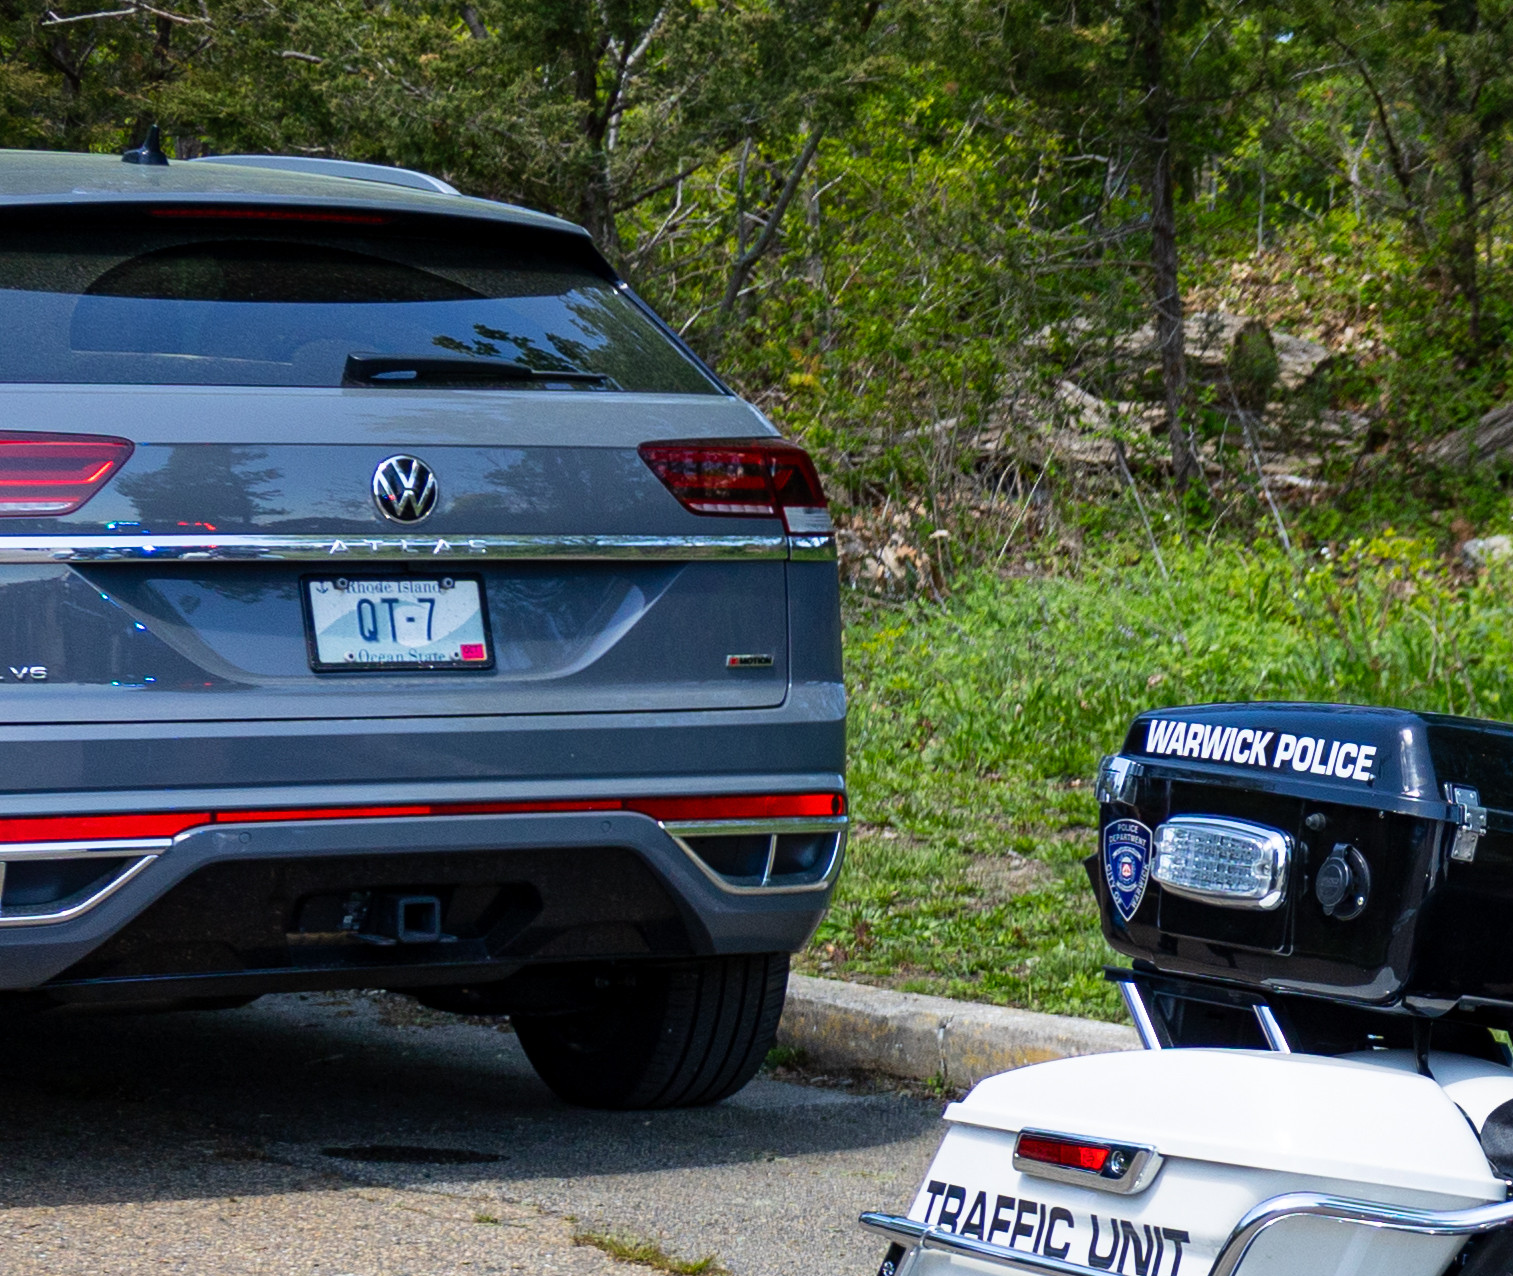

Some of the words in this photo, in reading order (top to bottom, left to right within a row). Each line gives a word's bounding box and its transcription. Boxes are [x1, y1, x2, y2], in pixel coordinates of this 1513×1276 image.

[329, 538, 487, 554] ATLAS
[357, 598, 435, 642] QT-7
[358, 648, 401, 662] Ocean
[408, 648, 446, 662] State
[9, 666, 47, 679] V6
[1146, 719, 1268, 768] WARWICK
[1273, 732, 1377, 781] POLICE
[1117, 823, 1139, 834] POLICE
[1108, 835, 1147, 847] DEPARTMENT
[924, 1180, 1075, 1260] TRAFFIC
